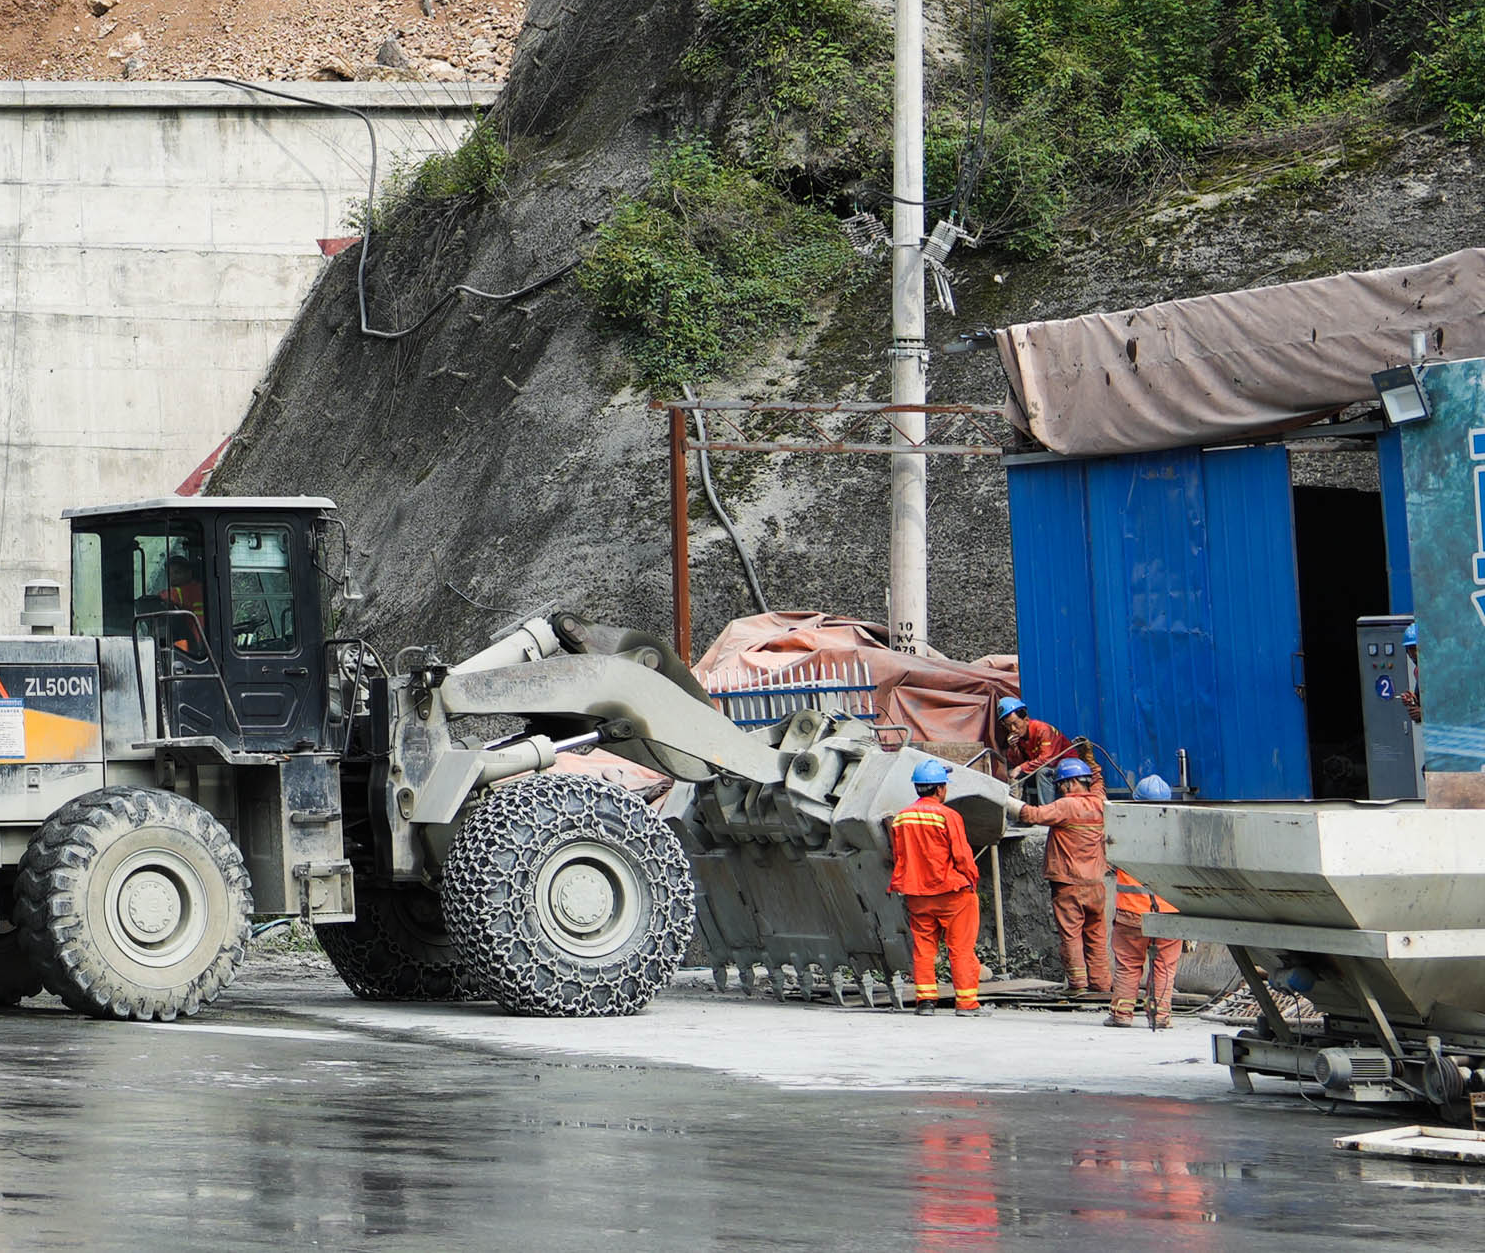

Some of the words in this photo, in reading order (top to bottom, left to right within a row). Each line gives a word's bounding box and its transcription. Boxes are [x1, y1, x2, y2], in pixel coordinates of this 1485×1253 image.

[898, 621, 913, 631] 10
[25, 676, 93, 697] ZL50CN
[1380, 679, 1390, 697] 2
